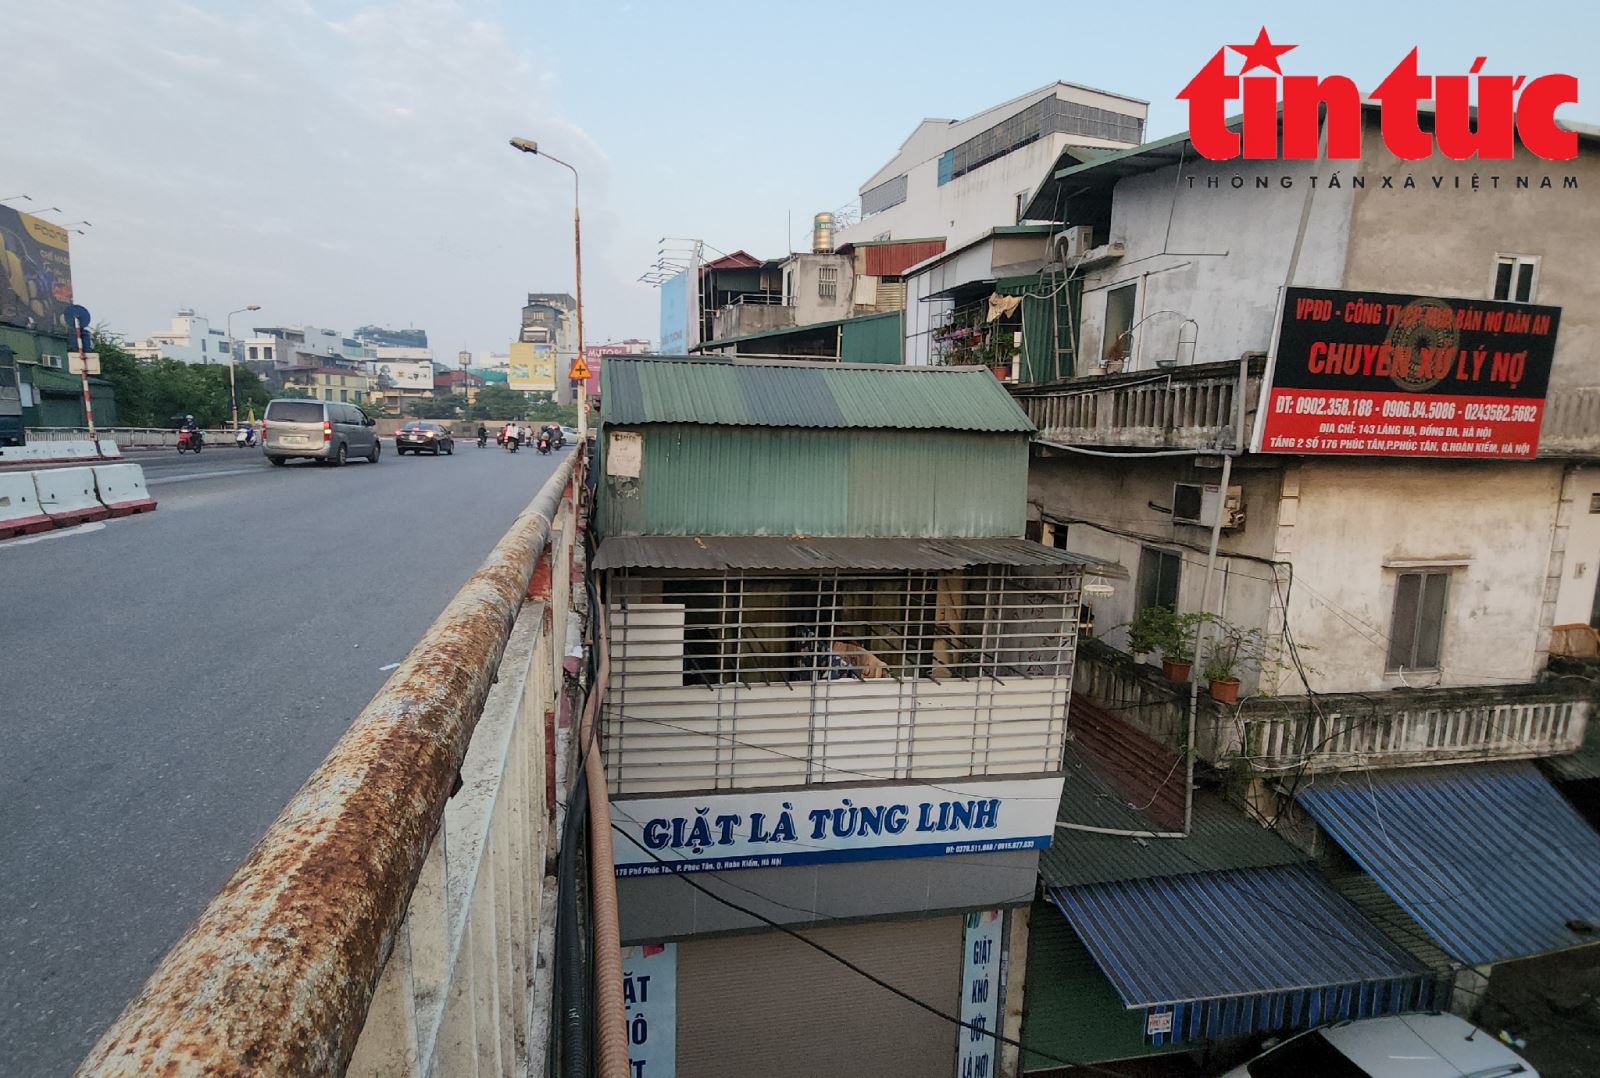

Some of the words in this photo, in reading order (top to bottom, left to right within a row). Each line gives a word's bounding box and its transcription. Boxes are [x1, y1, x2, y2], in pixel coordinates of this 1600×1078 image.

[1344, 298, 1382, 325] CÔNG
[1385, 304, 1402, 326] TY
[1484, 309, 1504, 336] NỢ
[1532, 315, 1550, 335] AN
[1308, 338, 1413, 378] CHUYÊN
[1456, 344, 1487, 381] LÝ
[1490, 350, 1527, 389] NỢ
[1295, 396, 1373, 417] 0902.358.188
[1382, 400, 1456, 420] 0906.84.5086
[1296, 438, 1304, 448] 2
[1305, 435, 1319, 448] SỐ
[1321, 439, 1338, 449] 176
[1501, 442, 1513, 454] HÀ
[1515, 444, 1530, 456] NỘI
[1319, 423, 1335, 435] ĐỊA
[1358, 425, 1375, 434] 143
[1419, 422, 1444, 437] ĐỐNG
[1462, 425, 1474, 438] HÀ
[1476, 426, 1492, 440] NỘI
[643, 806, 742, 855] GIẶT
[748, 802, 797, 844] LÀ
[808, 798, 909, 841] TÙNG
[916, 799, 1002, 833] LINH
[973, 936, 992, 970] GIẶT
[971, 974, 989, 1004] KHÔ
[963, 1051, 972, 1078] LÀ
[974, 1053, 989, 1078] HƠI
